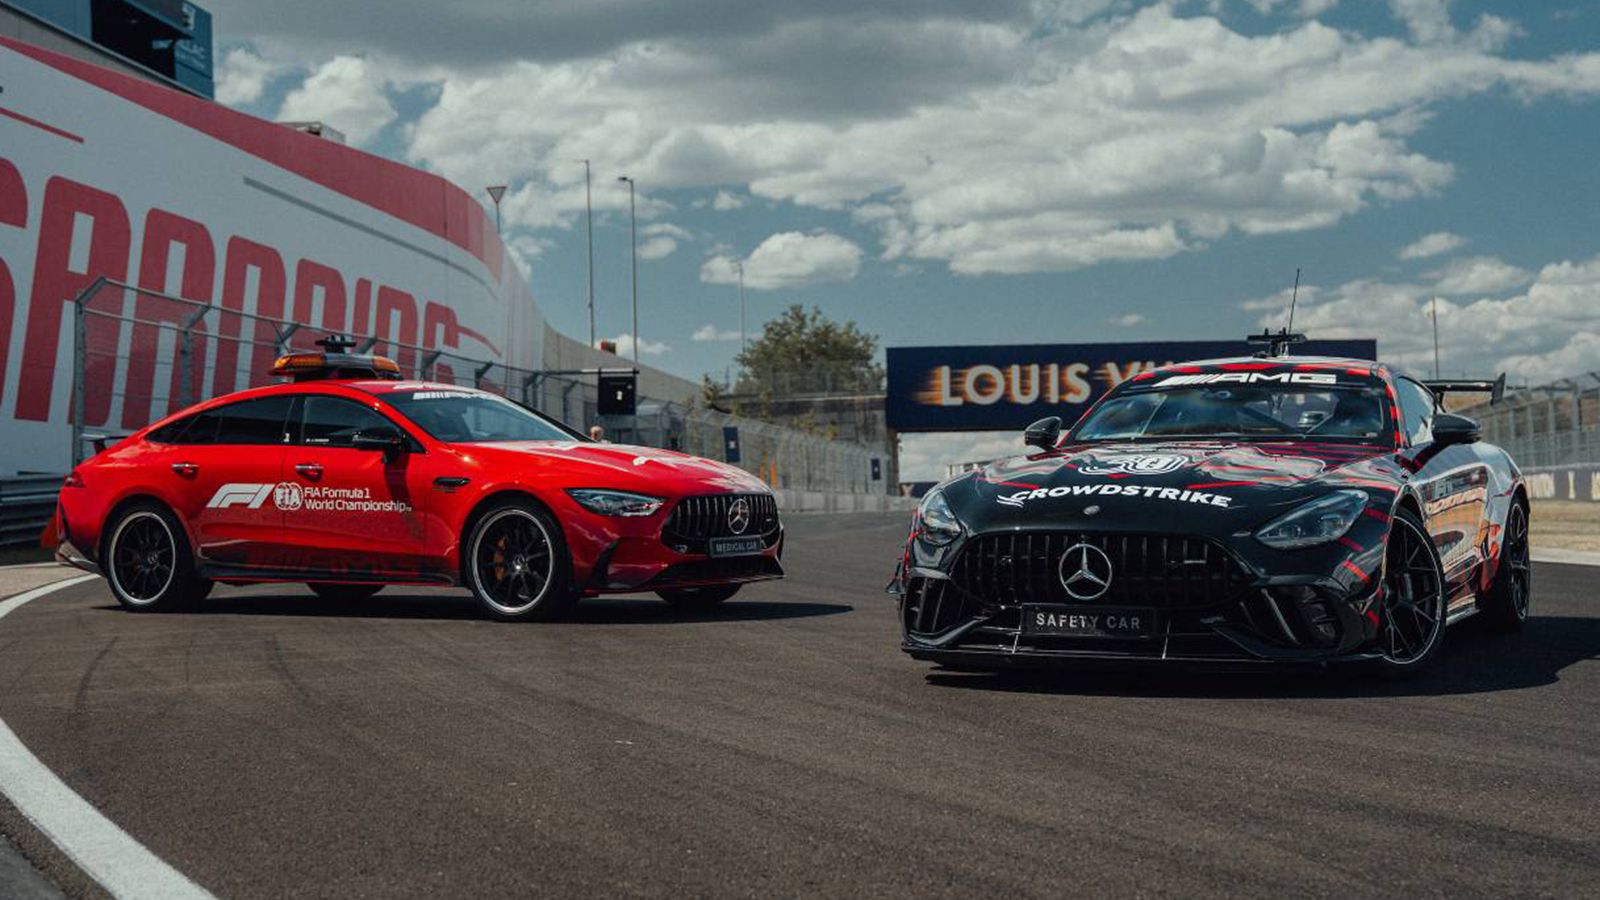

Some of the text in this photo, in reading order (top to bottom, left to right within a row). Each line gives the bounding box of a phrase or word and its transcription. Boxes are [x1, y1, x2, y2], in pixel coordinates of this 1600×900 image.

[941, 363, 1092, 406] LOUIS
[1209, 372, 1337, 384] AMG
[206, 483, 275, 508] F1
[304, 487, 371, 499] FIA Formula 1
[1009, 484, 1233, 508] CROWDSTRIKE
[305, 499, 334, 510] World
[335, 500, 406, 512] Championship
[716, 541, 757, 552] MEDICAL CAR
[1036, 613, 1141, 629] SAFETY CAR
